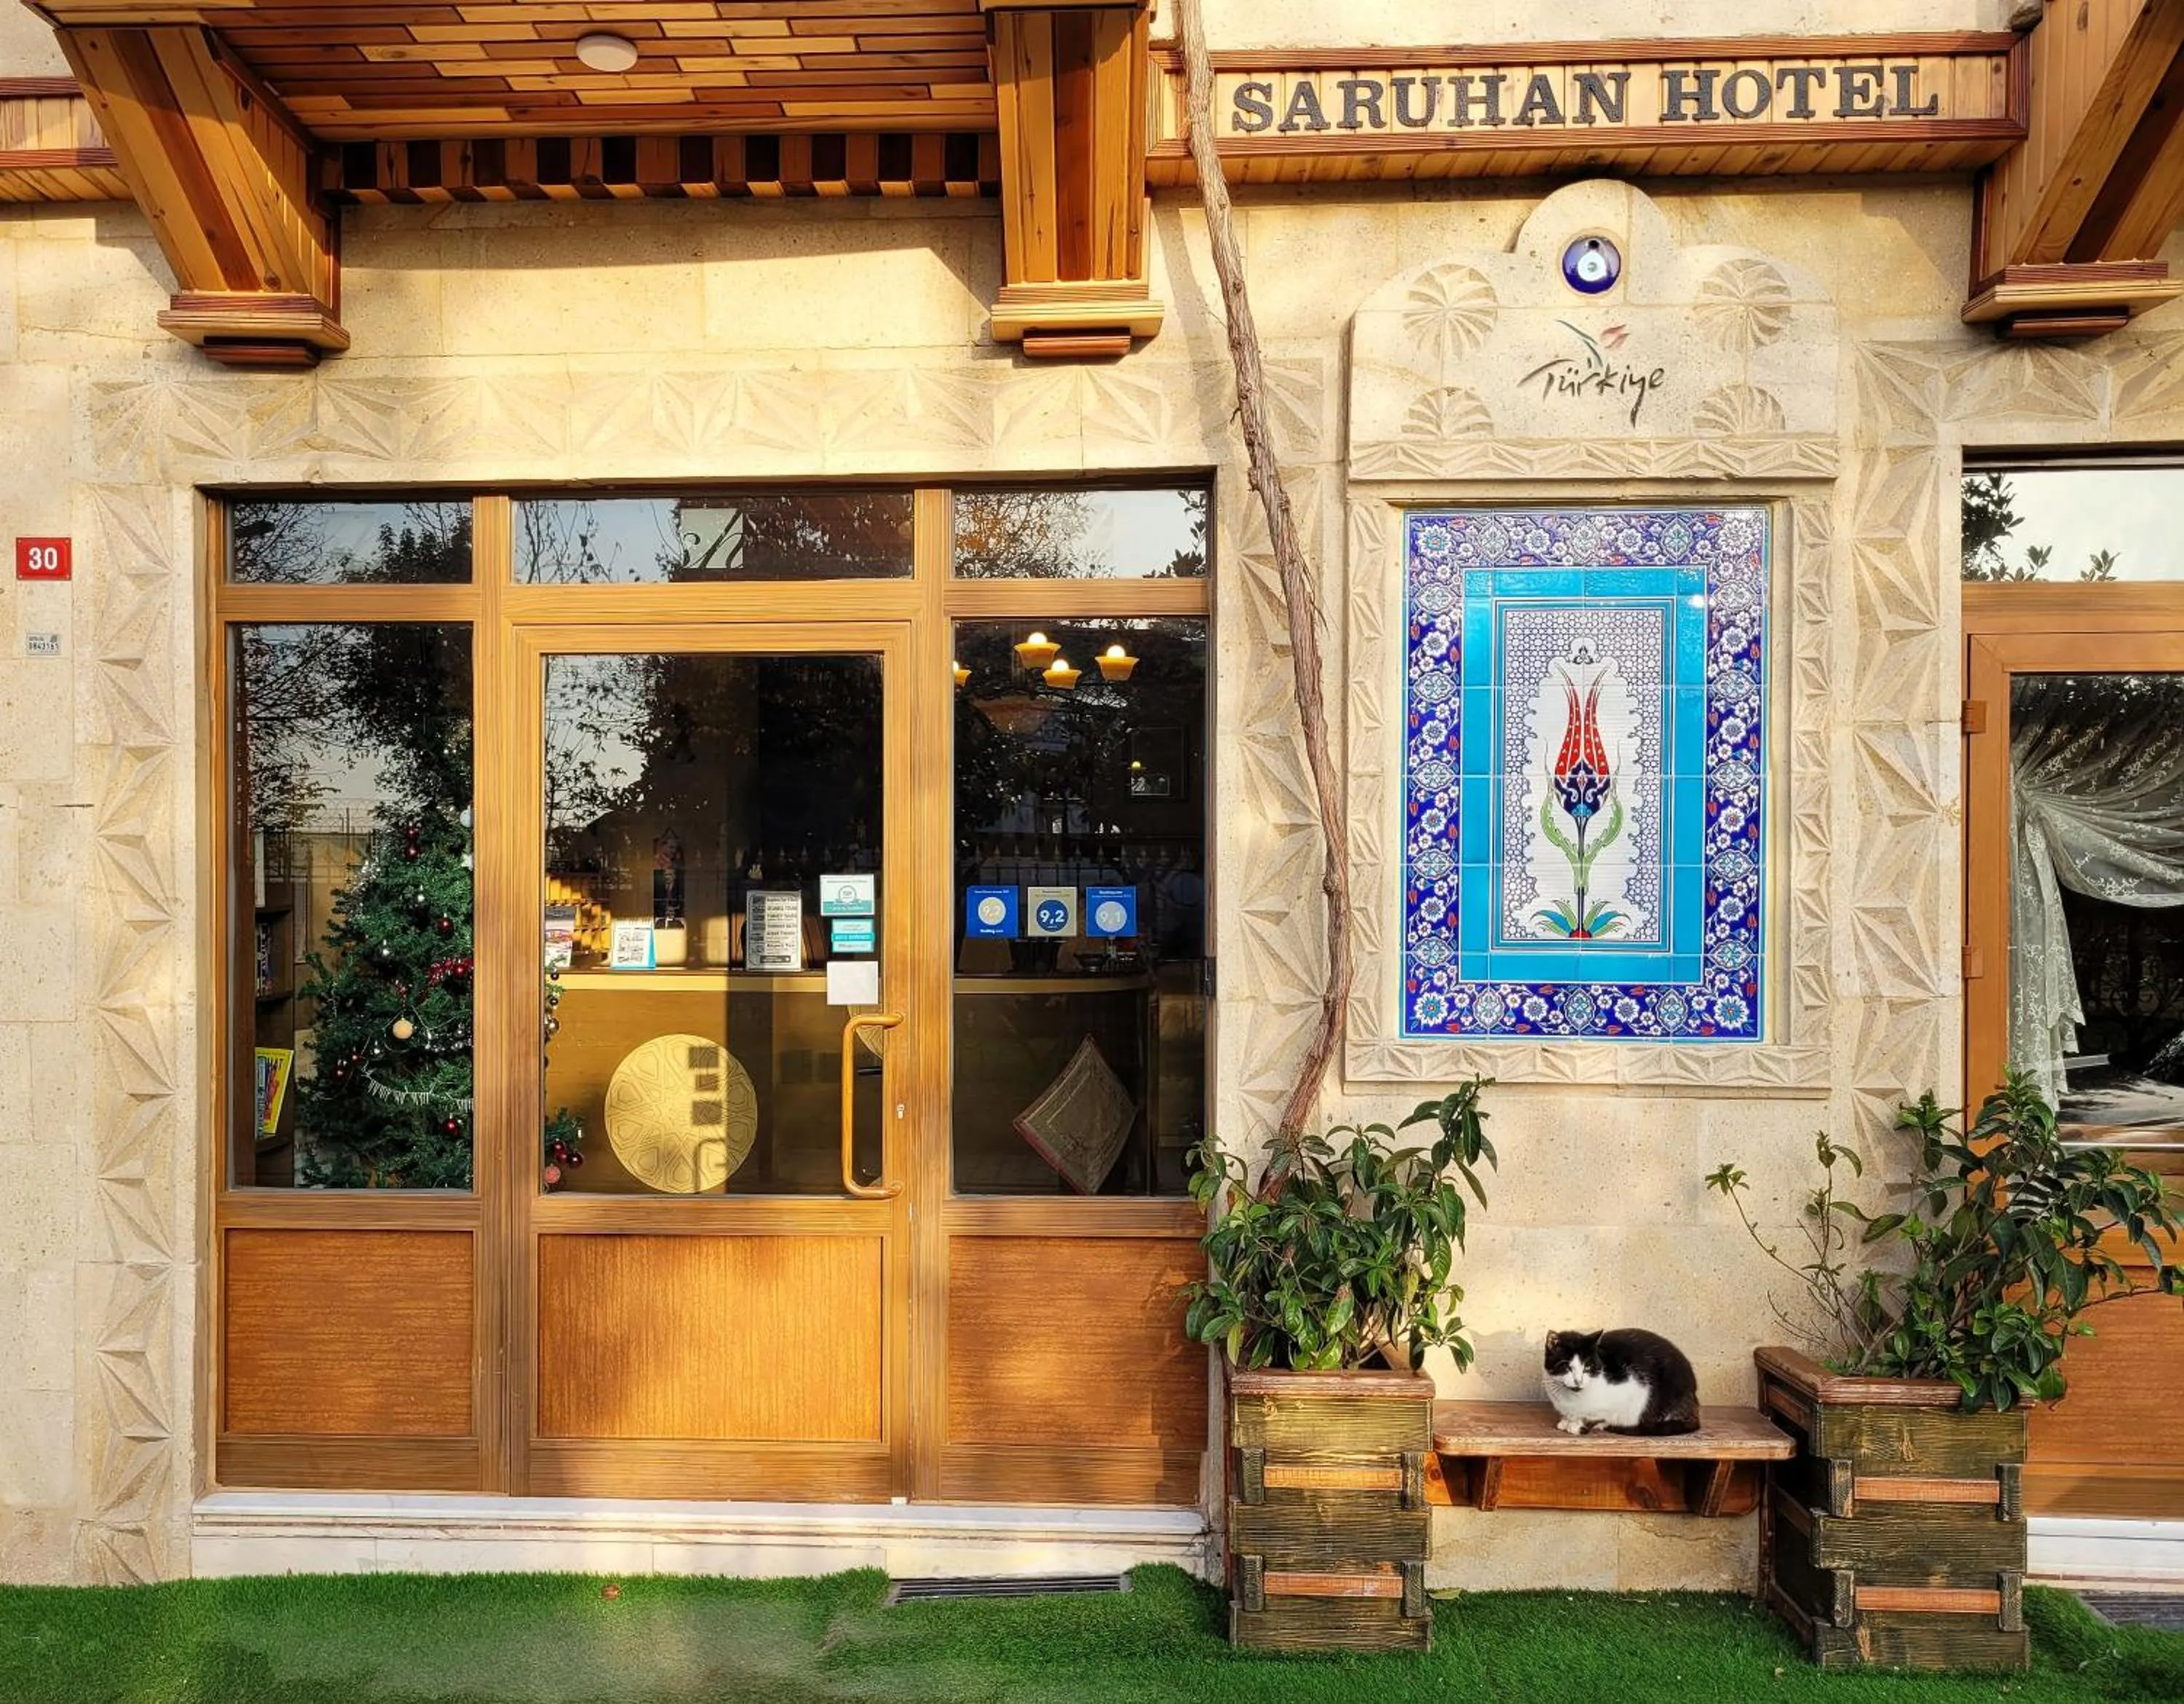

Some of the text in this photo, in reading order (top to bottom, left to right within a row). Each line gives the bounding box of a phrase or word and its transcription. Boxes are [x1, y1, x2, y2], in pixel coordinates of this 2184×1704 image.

[1232, 65, 1939, 133] SARUHAN HOTEL
[1516, 358, 1665, 429] Türkiye
[28, 547, 58, 570] 30
[1040, 910, 1065, 924] 9,2
